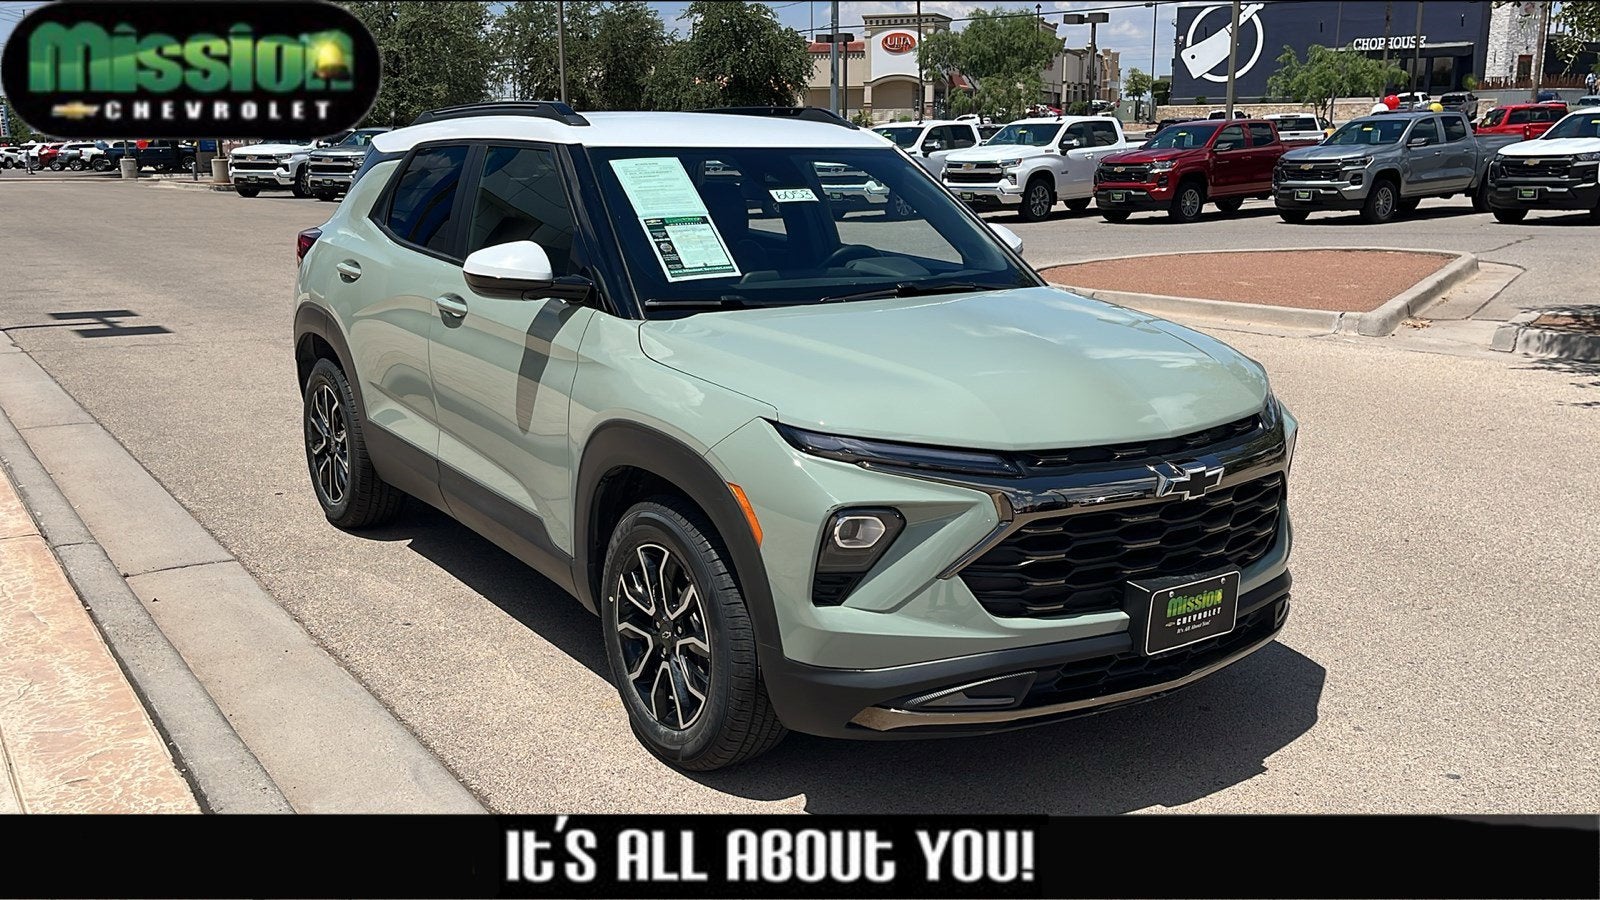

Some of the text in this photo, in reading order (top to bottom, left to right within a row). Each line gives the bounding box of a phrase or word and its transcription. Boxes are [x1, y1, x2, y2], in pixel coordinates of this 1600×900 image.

[887, 36, 911, 48] ULTA
[1353, 36, 1427, 51] CHOPHOUSE
[1167, 589, 1223, 617] Mission
[1176, 607, 1222, 626] CHEVROLET
